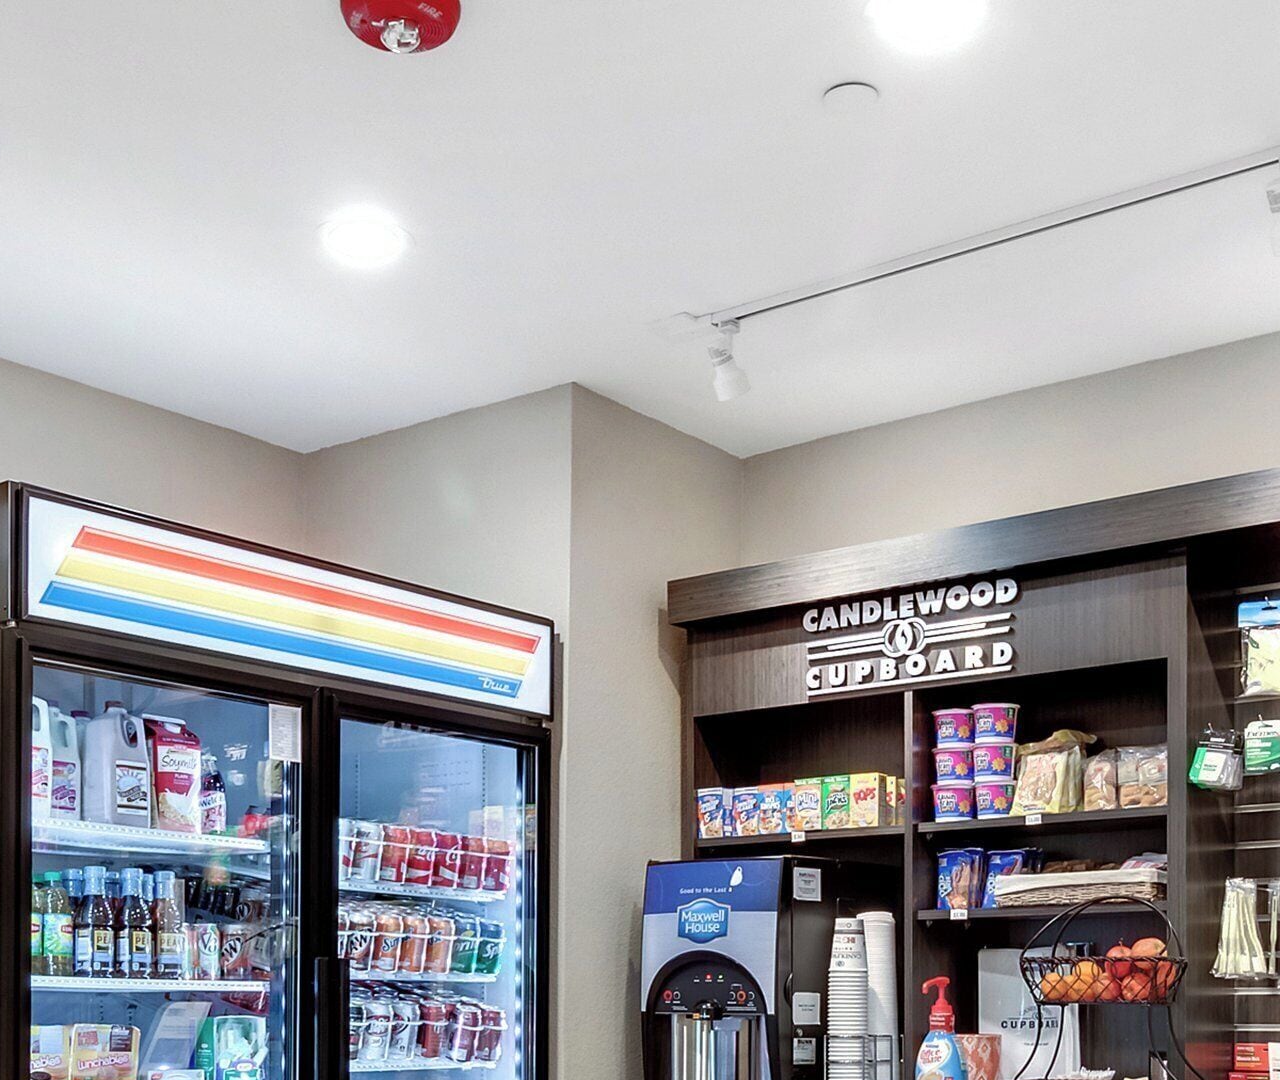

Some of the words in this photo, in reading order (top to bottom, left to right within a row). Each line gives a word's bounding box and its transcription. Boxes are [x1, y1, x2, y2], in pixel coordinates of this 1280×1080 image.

[803, 578, 1018, 632] CANDLEWOOD
[806, 642, 1013, 689] CUPBOARD
[853, 788, 876, 804] POPS
[681, 908, 725, 923] Maxwell
[684, 922, 720, 934] House
[77, 1054, 130, 1070] Lunchables
